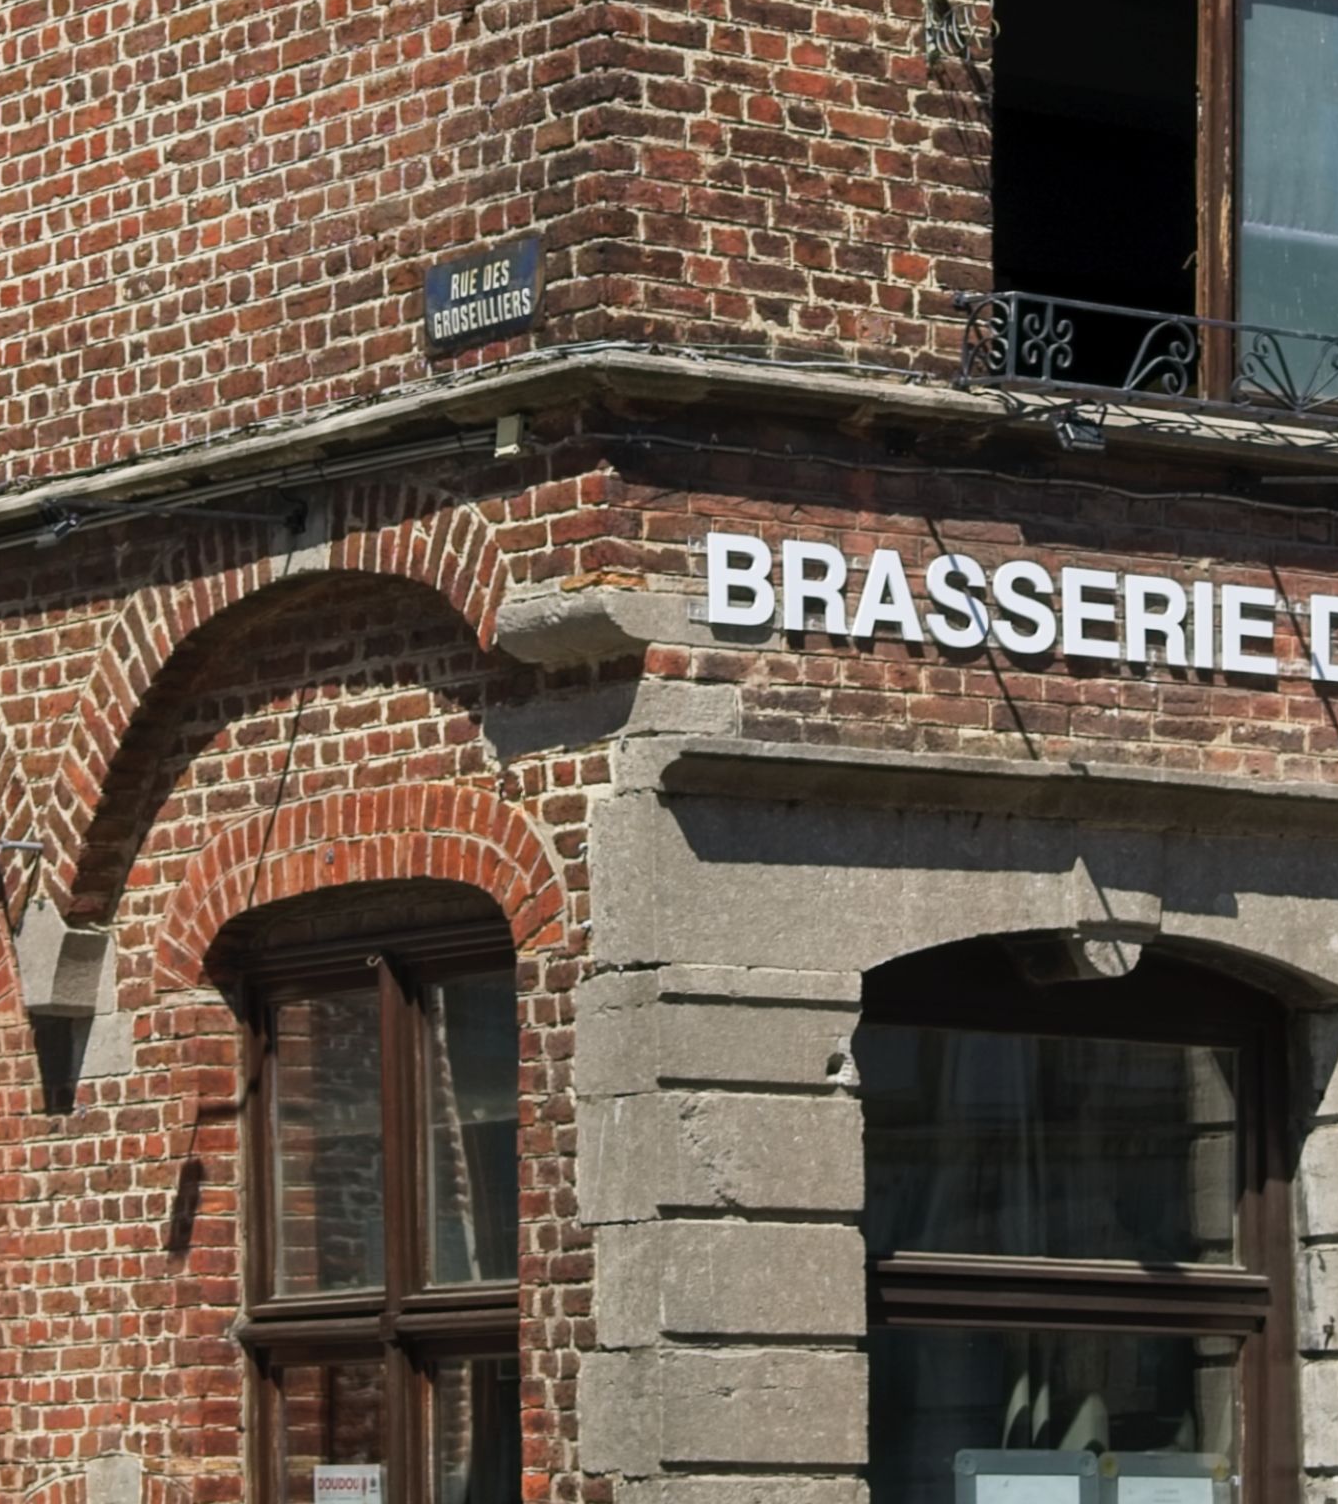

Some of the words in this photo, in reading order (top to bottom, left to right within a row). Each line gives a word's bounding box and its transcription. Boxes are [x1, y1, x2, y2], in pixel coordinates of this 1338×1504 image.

[450, 268, 478, 301] RUE
[483, 259, 510, 291] DES
[434, 287, 531, 339] GROSEILLIERS
[707, 532, 1278, 676] BRASSERIE
[318, 1477, 359, 1490] DOUDOU
